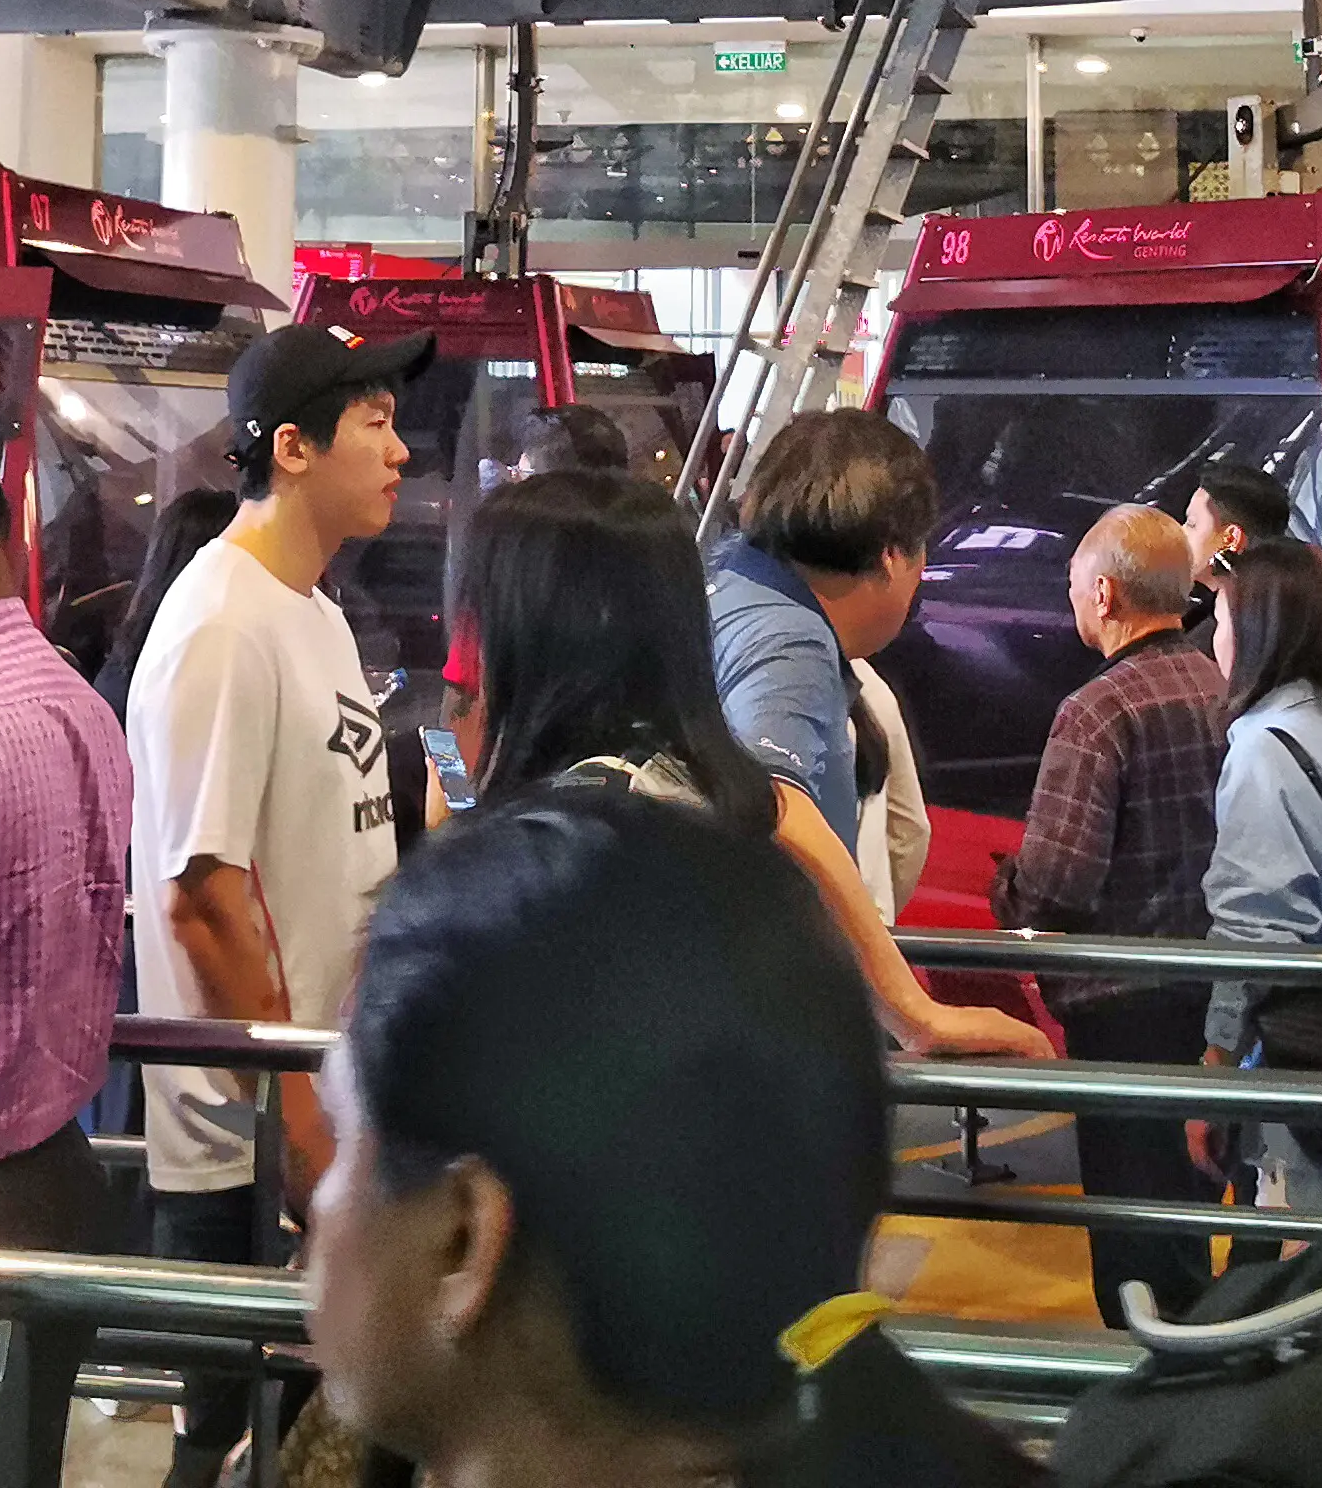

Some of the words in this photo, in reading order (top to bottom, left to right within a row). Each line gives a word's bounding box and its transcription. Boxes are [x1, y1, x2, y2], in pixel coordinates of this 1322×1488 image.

[730, 53, 784, 70] KELUAR
[940, 229, 972, 265] 98
[1133, 243, 1188, 259] GENTING
